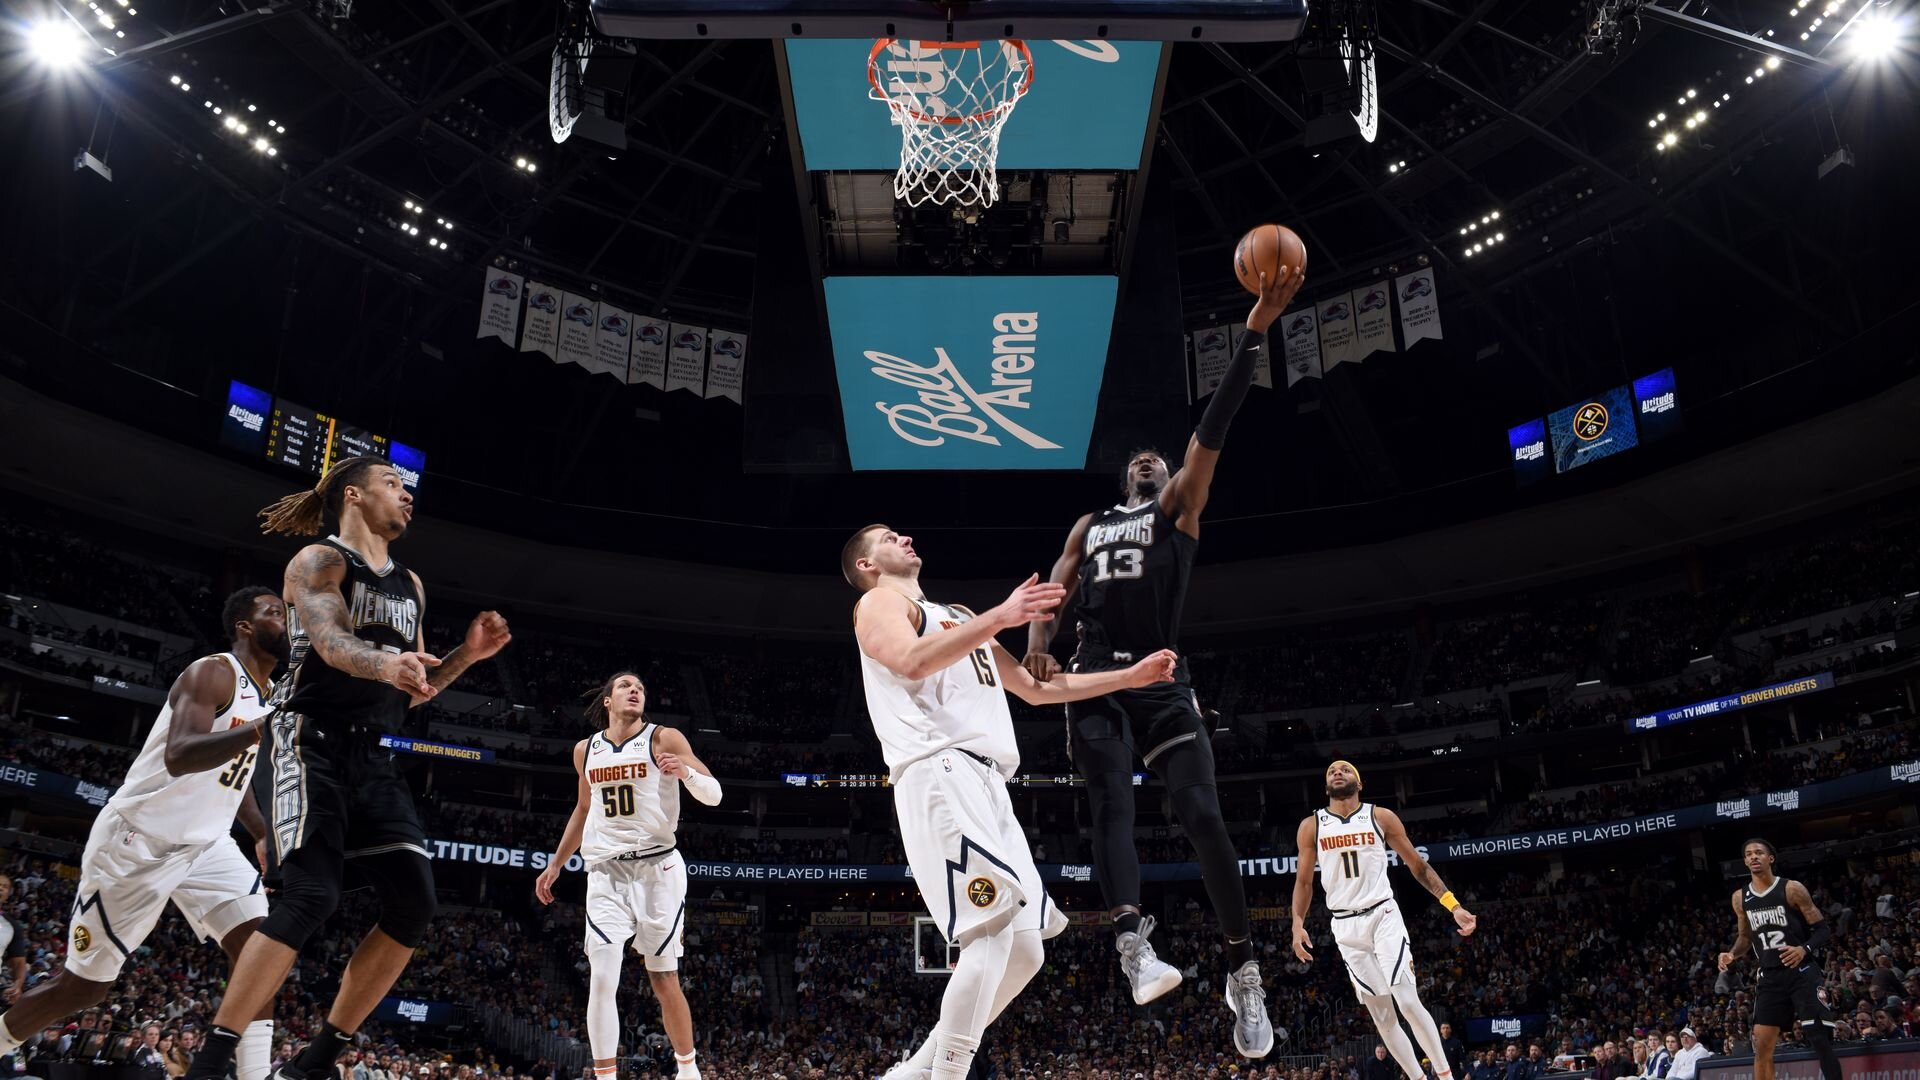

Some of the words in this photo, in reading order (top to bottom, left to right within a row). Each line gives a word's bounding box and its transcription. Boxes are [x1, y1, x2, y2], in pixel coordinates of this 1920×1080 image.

[1410, 317, 1432, 328] TROPHY
[978, 312, 1038, 409] Arena
[863, 347, 1064, 449] Ball
[1642, 392, 1674, 412] Altitude
[1658, 402, 1675, 413] sports
[228, 404, 264, 425] Altitude
[1515, 440, 1544, 459] Altitude
[1086, 512, 1155, 558] MEMPHIS
[1093, 548, 1145, 583] 13
[350, 580, 418, 643] MEMPHIS
[970, 648, 996, 688] 15
[1667, 711, 1683, 721] YOUR
[1683, 707, 1695, 718] TV
[1695, 701, 1720, 716] HOME
[1720, 701, 1728, 709] OF
[1728, 698, 1739, 707] THE
[1741, 689, 1775, 705] DENVER
[1775, 679, 1817, 697] NUGGETS
[393, 740, 401, 748] OF
[401, 741, 412, 749] THE
[412, 742, 443, 755] DENVER
[444, 747, 481, 761] NUGGETS
[219, 750, 256, 791] 32
[589, 762, 648, 785] NUGGETS
[601, 784, 636, 818] 50
[1716, 798, 1750, 816] Altitude
[1766, 789, 1799, 806] Altitude
[1733, 809, 1751, 819] sports
[1319, 832, 1375, 852] NUGGETS
[1449, 836, 1532, 857] MEMORIES
[1536, 832, 1568, 847] ARE
[1572, 823, 1631, 843] PLAYED
[1635, 814, 1677, 833] HERE
[424, 839, 525, 867] LTITUDE
[687, 864, 731, 877] ORIES
[735, 867, 765, 879] ARE
[768, 868, 824, 880] PLAYED
[828, 868, 868, 880] HERE
[1061, 864, 1091, 878] Altitude
[1341, 850, 1360, 878] 11
[815, 911, 847, 925] Coors
[1746, 905, 1788, 931] MEMPHIS
[1758, 930, 1787, 950] 12
[397, 1000, 429, 1017] Altitude
[1491, 1018, 1521, 1034] Altitude
